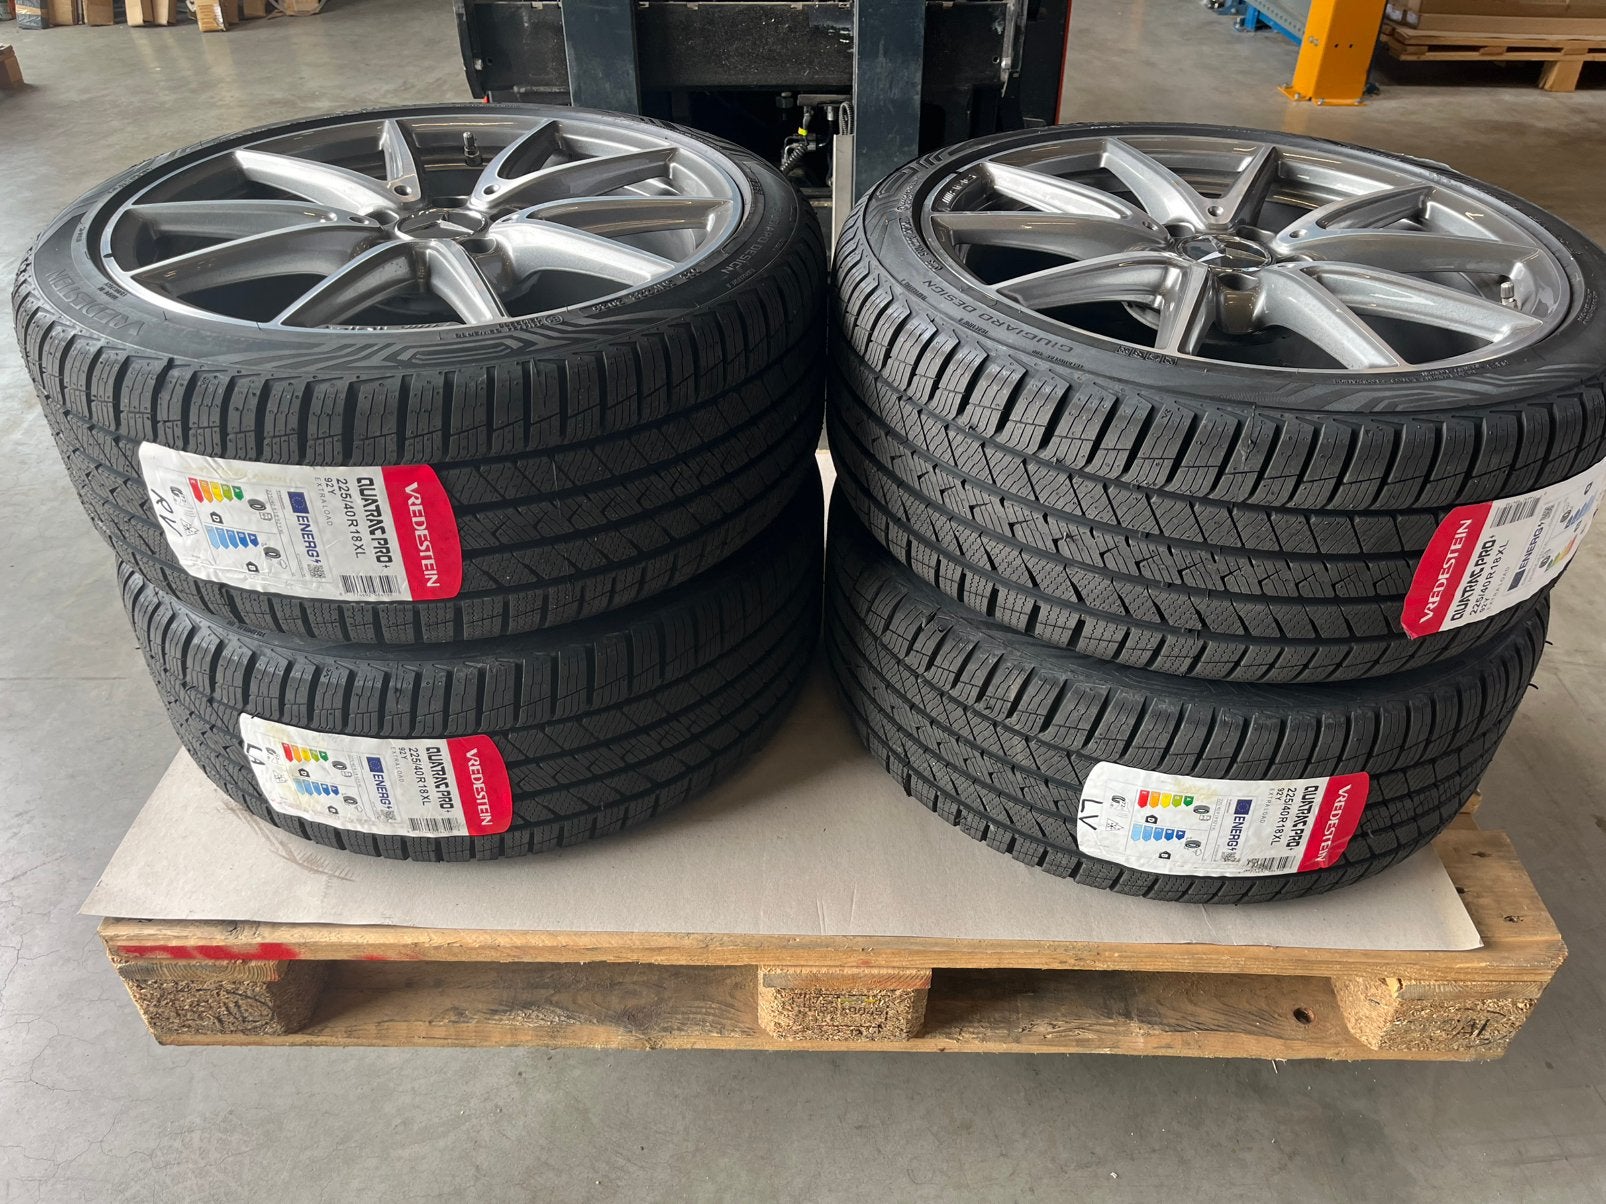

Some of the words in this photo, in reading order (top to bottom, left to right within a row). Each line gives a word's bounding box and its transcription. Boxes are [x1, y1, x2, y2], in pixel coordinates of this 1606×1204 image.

[721, 243, 761, 274] DESIGN
[922, 279, 977, 313] DESIGN
[979, 313, 1074, 353] GIUGIARO
[356, 477, 386, 535] QUATRAC
[296, 514, 320, 559] ENERG
[404, 481, 440, 587] VREDESTEIN
[1519, 526, 1544, 569] ENERG
[1419, 519, 1473, 624] VREDESTEIN
[1450, 566, 1484, 622] QUATRAC
[425, 746, 449, 789] QUATRAC
[465, 748, 493, 826] VREDESTEIN
[372, 773, 391, 806] ENERG
[1292, 785, 1319, 828] QUATRAC
[1227, 816, 1246, 847] ENERG
[1315, 784, 1352, 861] VREDESTEIN
